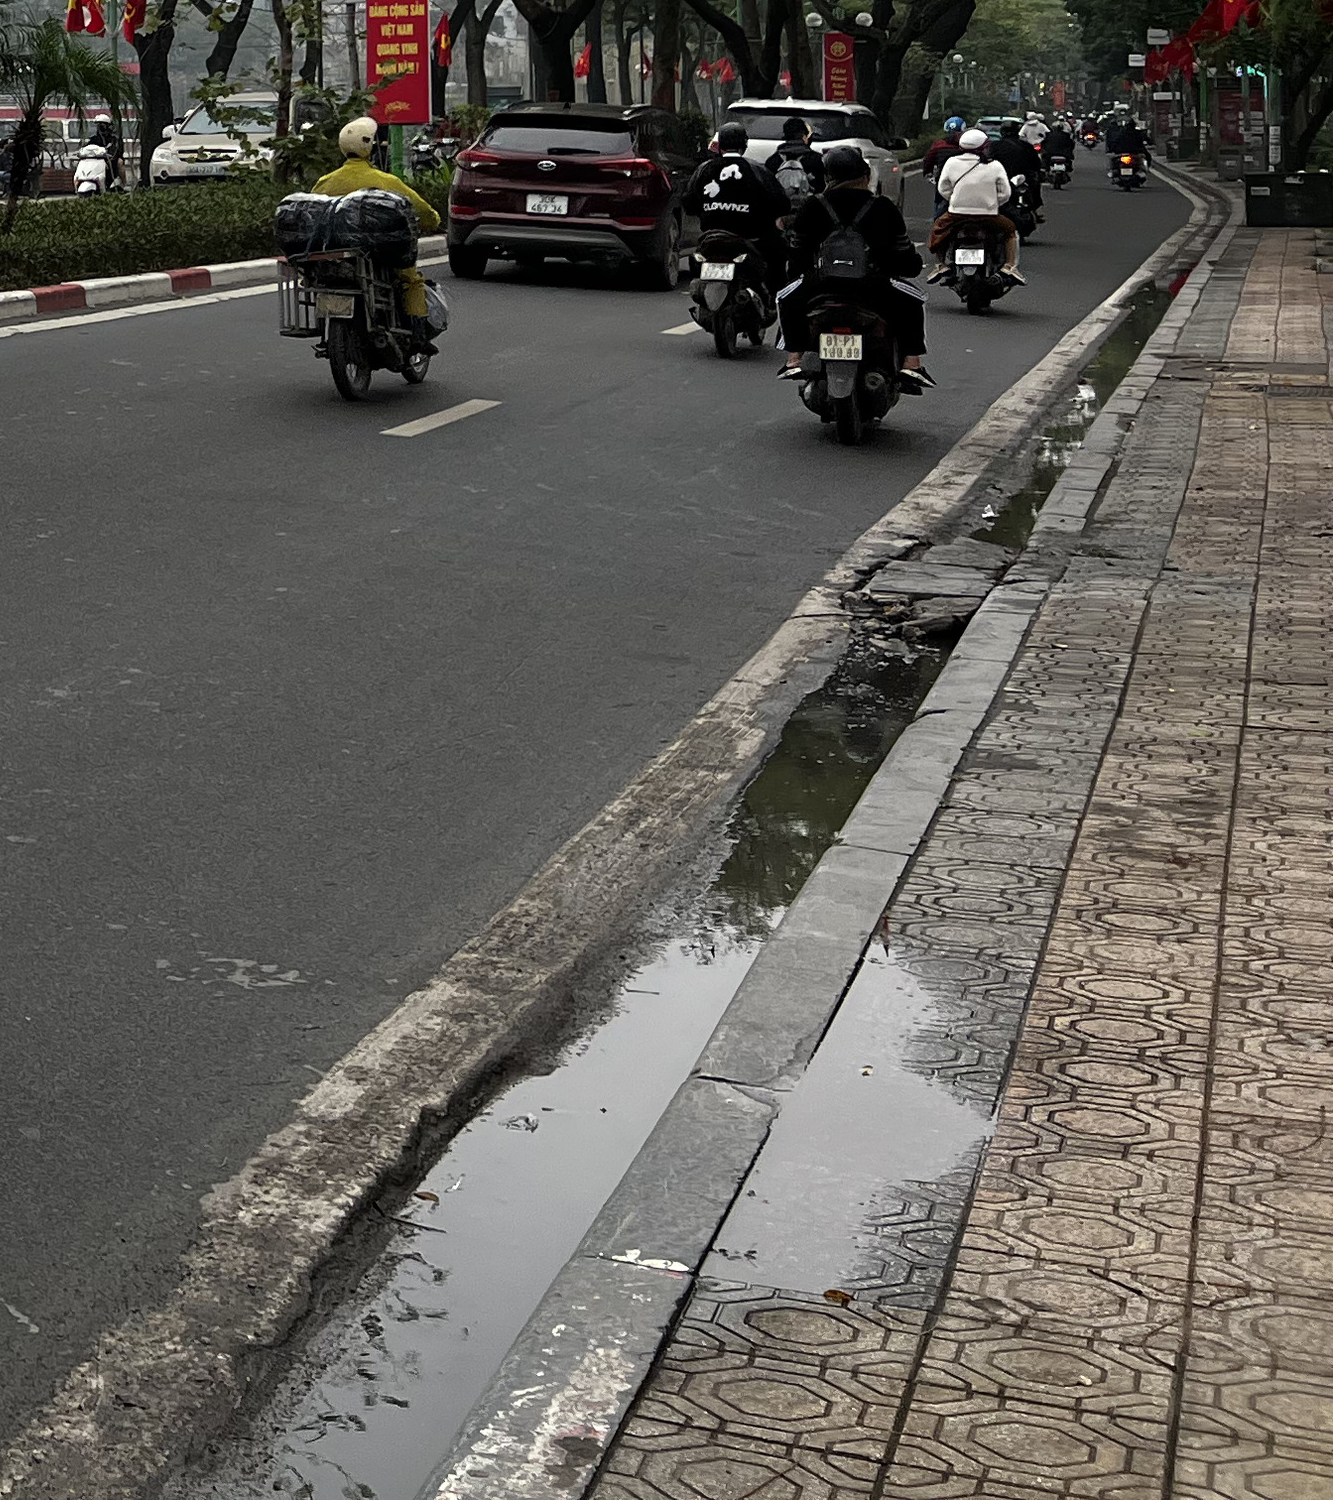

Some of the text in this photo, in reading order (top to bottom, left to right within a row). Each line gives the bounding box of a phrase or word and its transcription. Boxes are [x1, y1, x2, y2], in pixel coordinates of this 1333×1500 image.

[409, 0, 425, 16] SẢN
[380, 22, 413, 38] VIỆT NAM
[376, 43, 400, 57] QUANG
